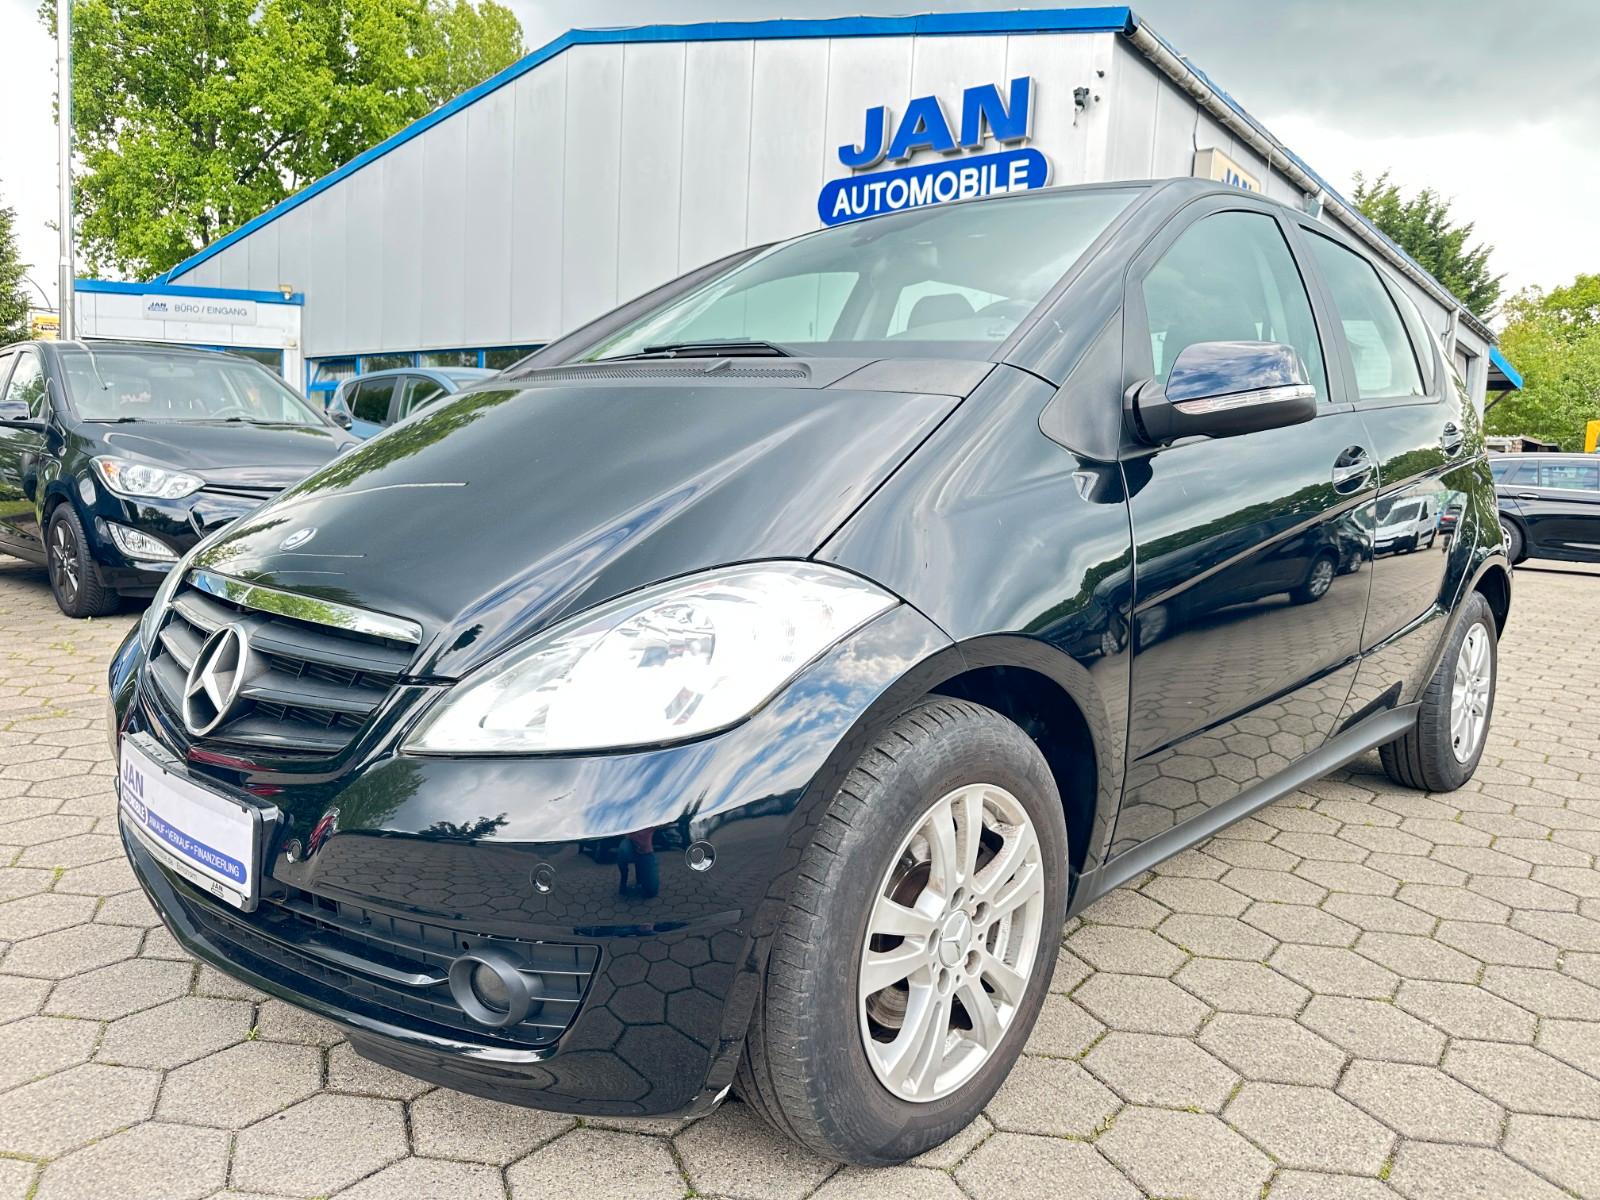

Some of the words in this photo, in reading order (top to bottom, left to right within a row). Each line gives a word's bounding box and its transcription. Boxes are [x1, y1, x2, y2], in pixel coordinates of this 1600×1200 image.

[838, 76, 1033, 169] JAN
[832, 159, 1030, 217] AUTOMOBILE
[174, 303, 200, 313] BÜRO
[207, 306, 248, 316] EINGANG
[123, 759, 144, 798] JAN
[193, 844, 240, 877] FINANZIERUNG
